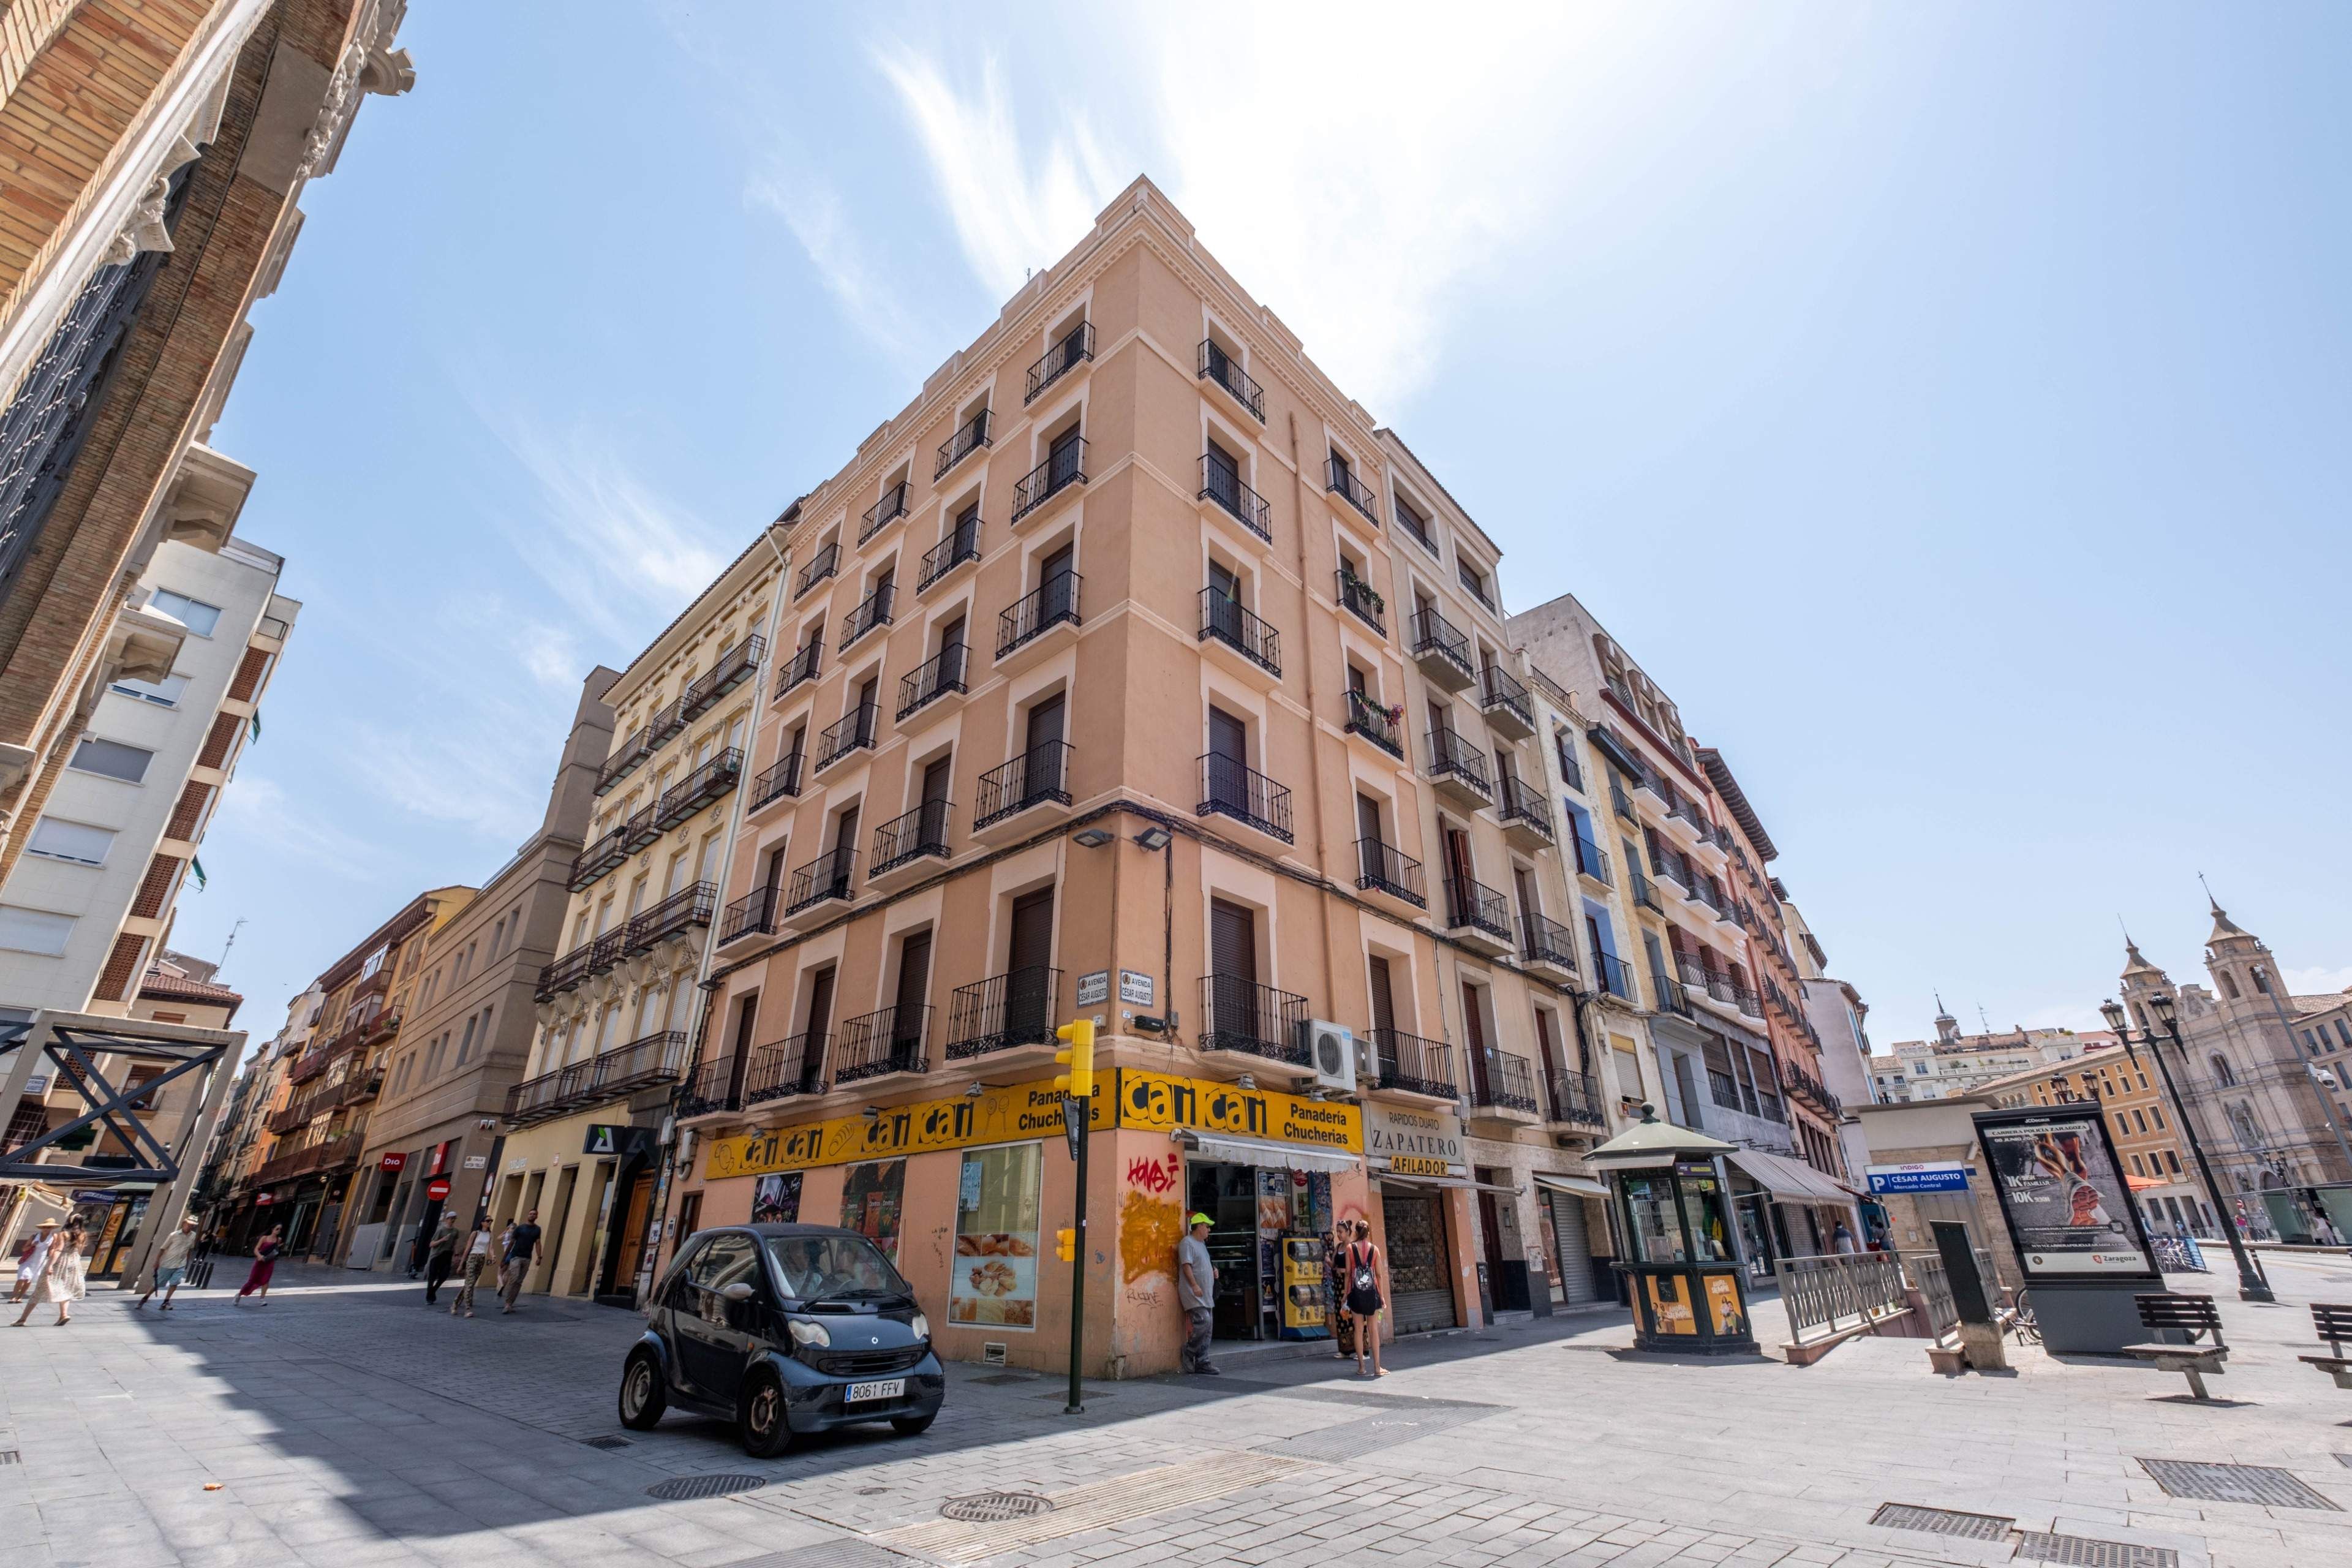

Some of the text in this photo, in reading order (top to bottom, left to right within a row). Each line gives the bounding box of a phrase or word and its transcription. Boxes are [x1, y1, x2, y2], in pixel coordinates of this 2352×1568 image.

[1088, 976, 1106, 986] AVENIDA
[1132, 978, 1151, 988] AVENIDA
[1090, 987, 1107, 999] AUGUSTO
[1135, 990, 1152, 1002] AUGUSTO
[1291, 1103, 1347, 1125] Panadería
[1389, 1112, 1439, 1131] RAPIDOS DUATO
[1284, 1121, 1348, 1145] Chucherias
[1373, 1130, 1457, 1156] ZAPATERO
[1393, 1157, 1446, 1175] AFILADOR
[1871, 1177, 1885, 1191] P
[2011, 1191, 2034, 1203] 10K
[853, 1382, 900, 1399] 8061 FFV
